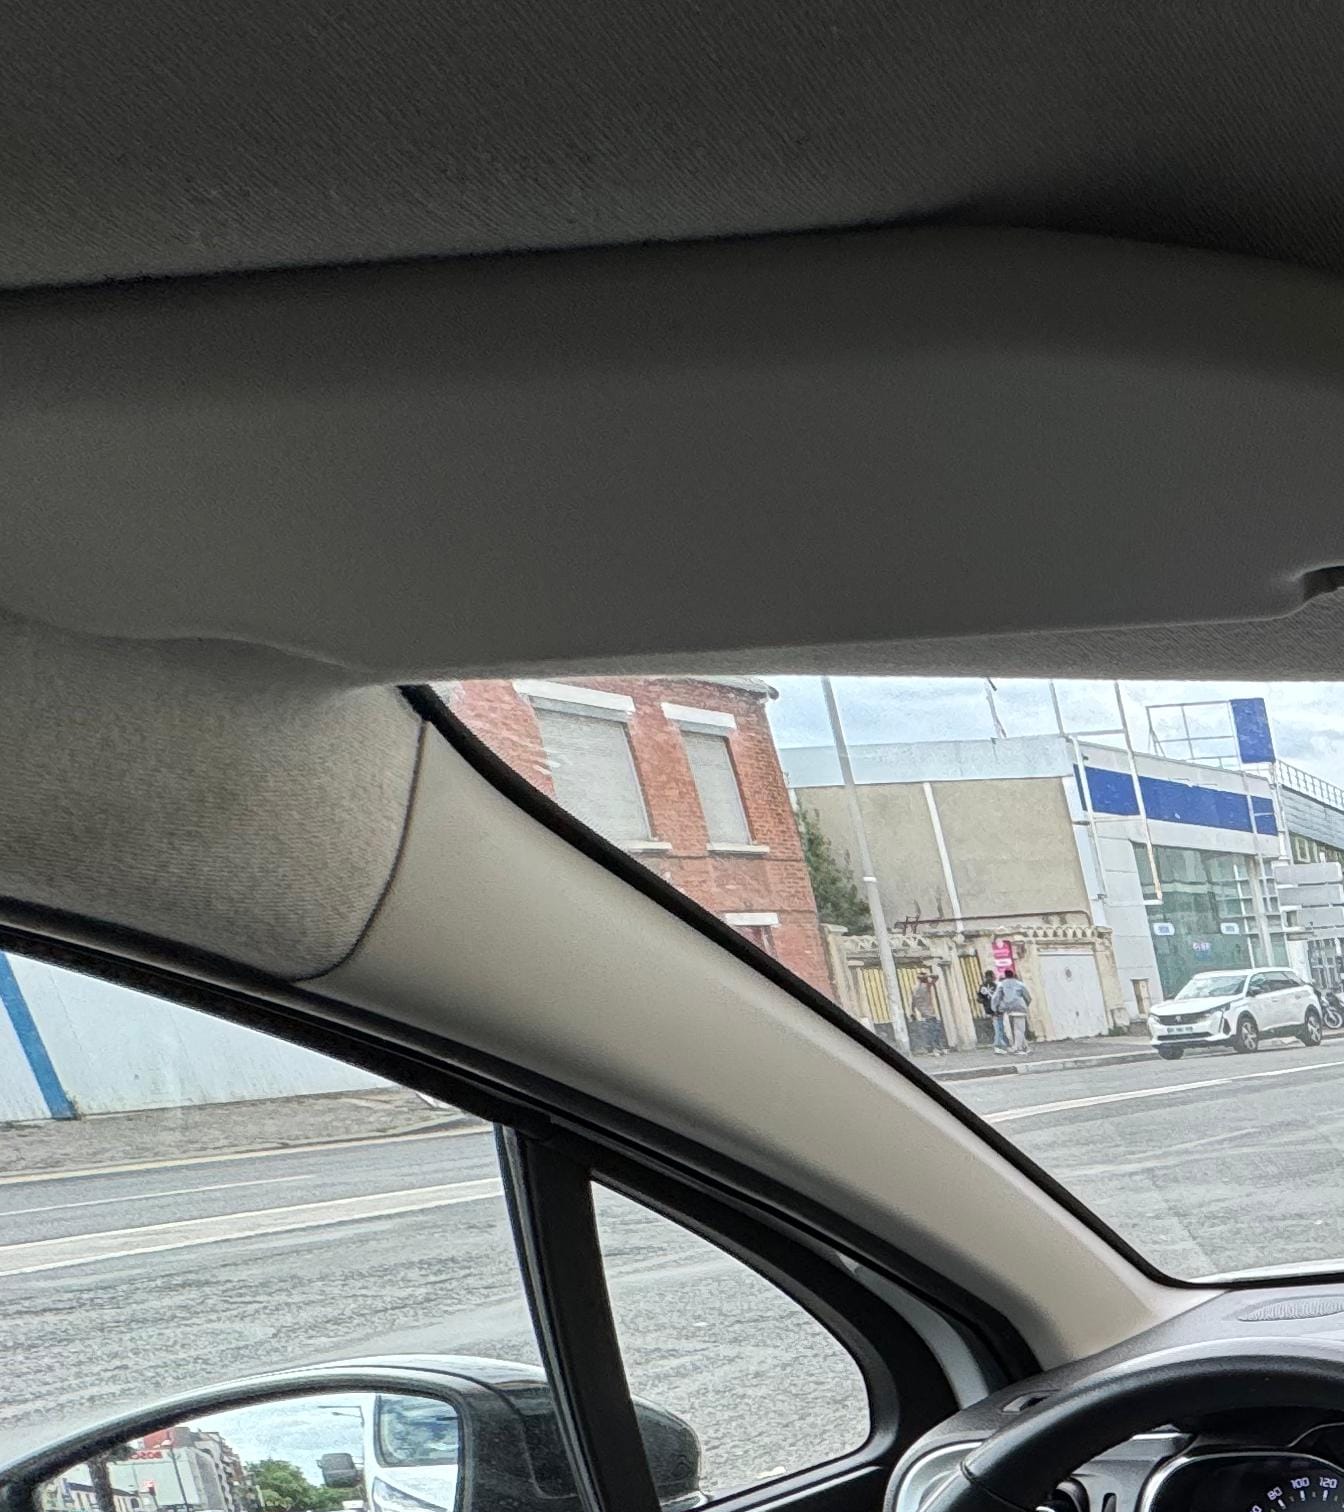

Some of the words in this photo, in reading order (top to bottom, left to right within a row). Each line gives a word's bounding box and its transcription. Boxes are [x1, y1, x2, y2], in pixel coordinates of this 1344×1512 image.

[1290, 1477, 1310, 1489] 100
[1319, 1476, 1338, 1488] 120
[1267, 1486, 1283, 1500] 80
